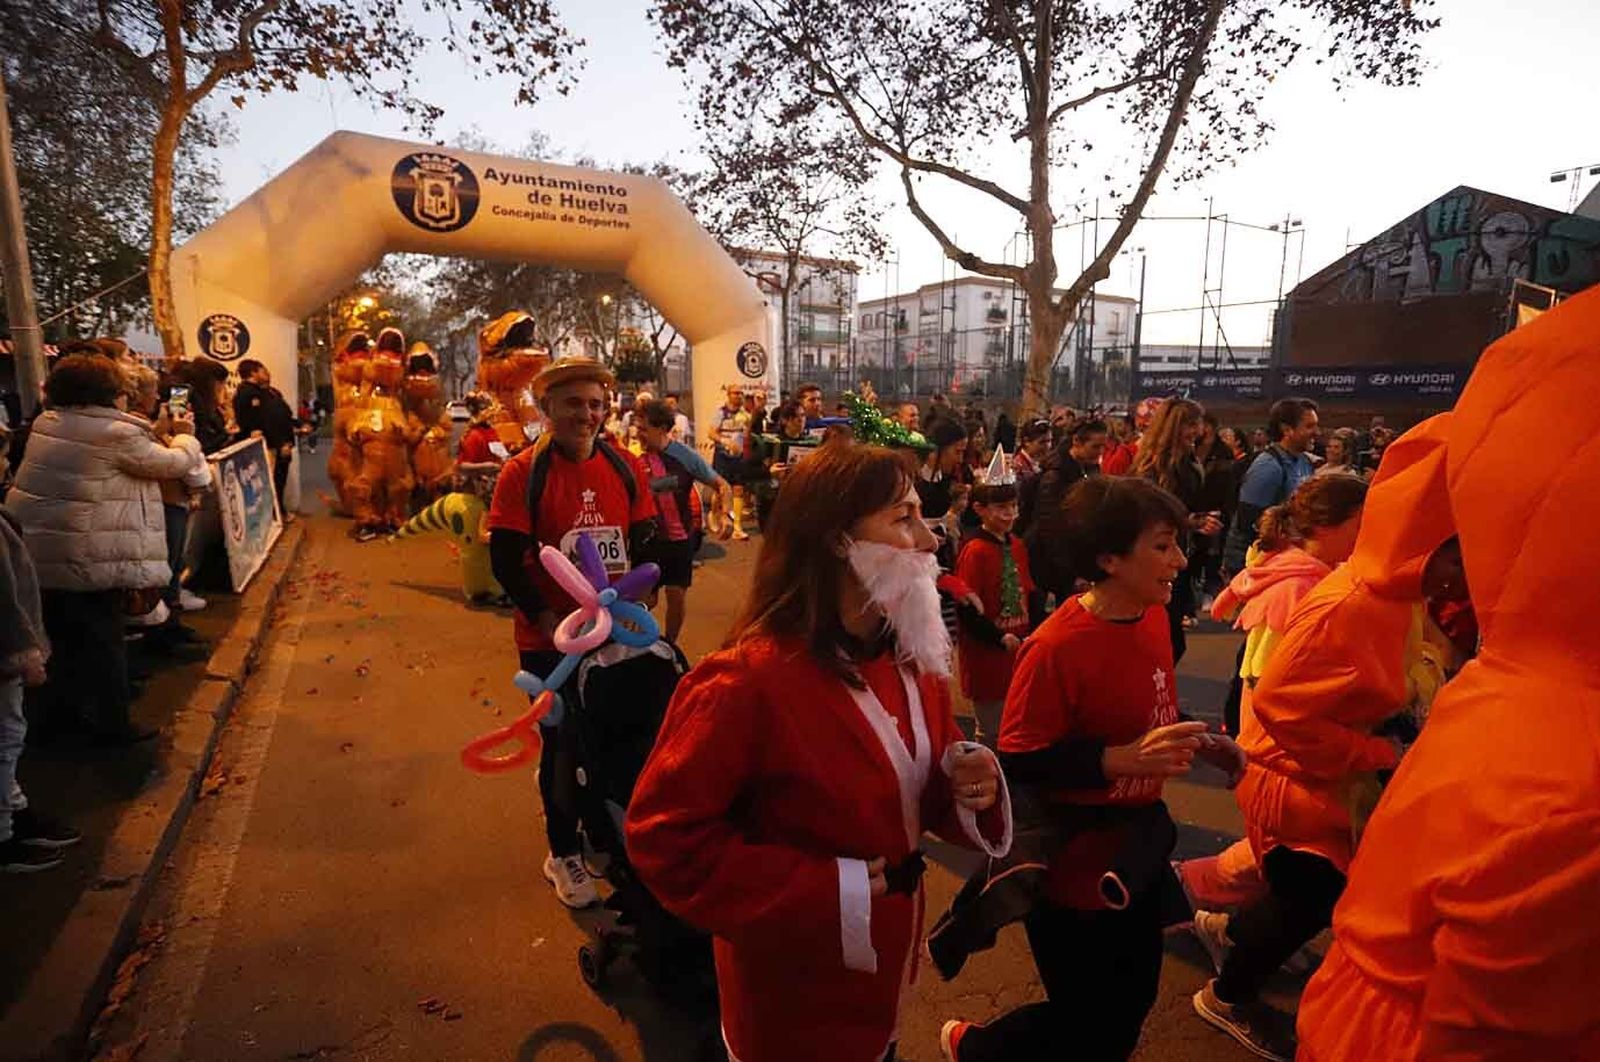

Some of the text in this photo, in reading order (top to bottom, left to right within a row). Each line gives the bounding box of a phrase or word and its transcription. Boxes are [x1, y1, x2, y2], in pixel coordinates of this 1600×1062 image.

[484, 167, 627, 198] Ayuntamiento
[528, 190, 628, 214] de Huelva
[560, 212, 575, 223] de
[578, 214, 630, 229] Deportes
[1304, 375, 1356, 385] HYUNDAI
[1393, 373, 1454, 384] HYUNDAI
